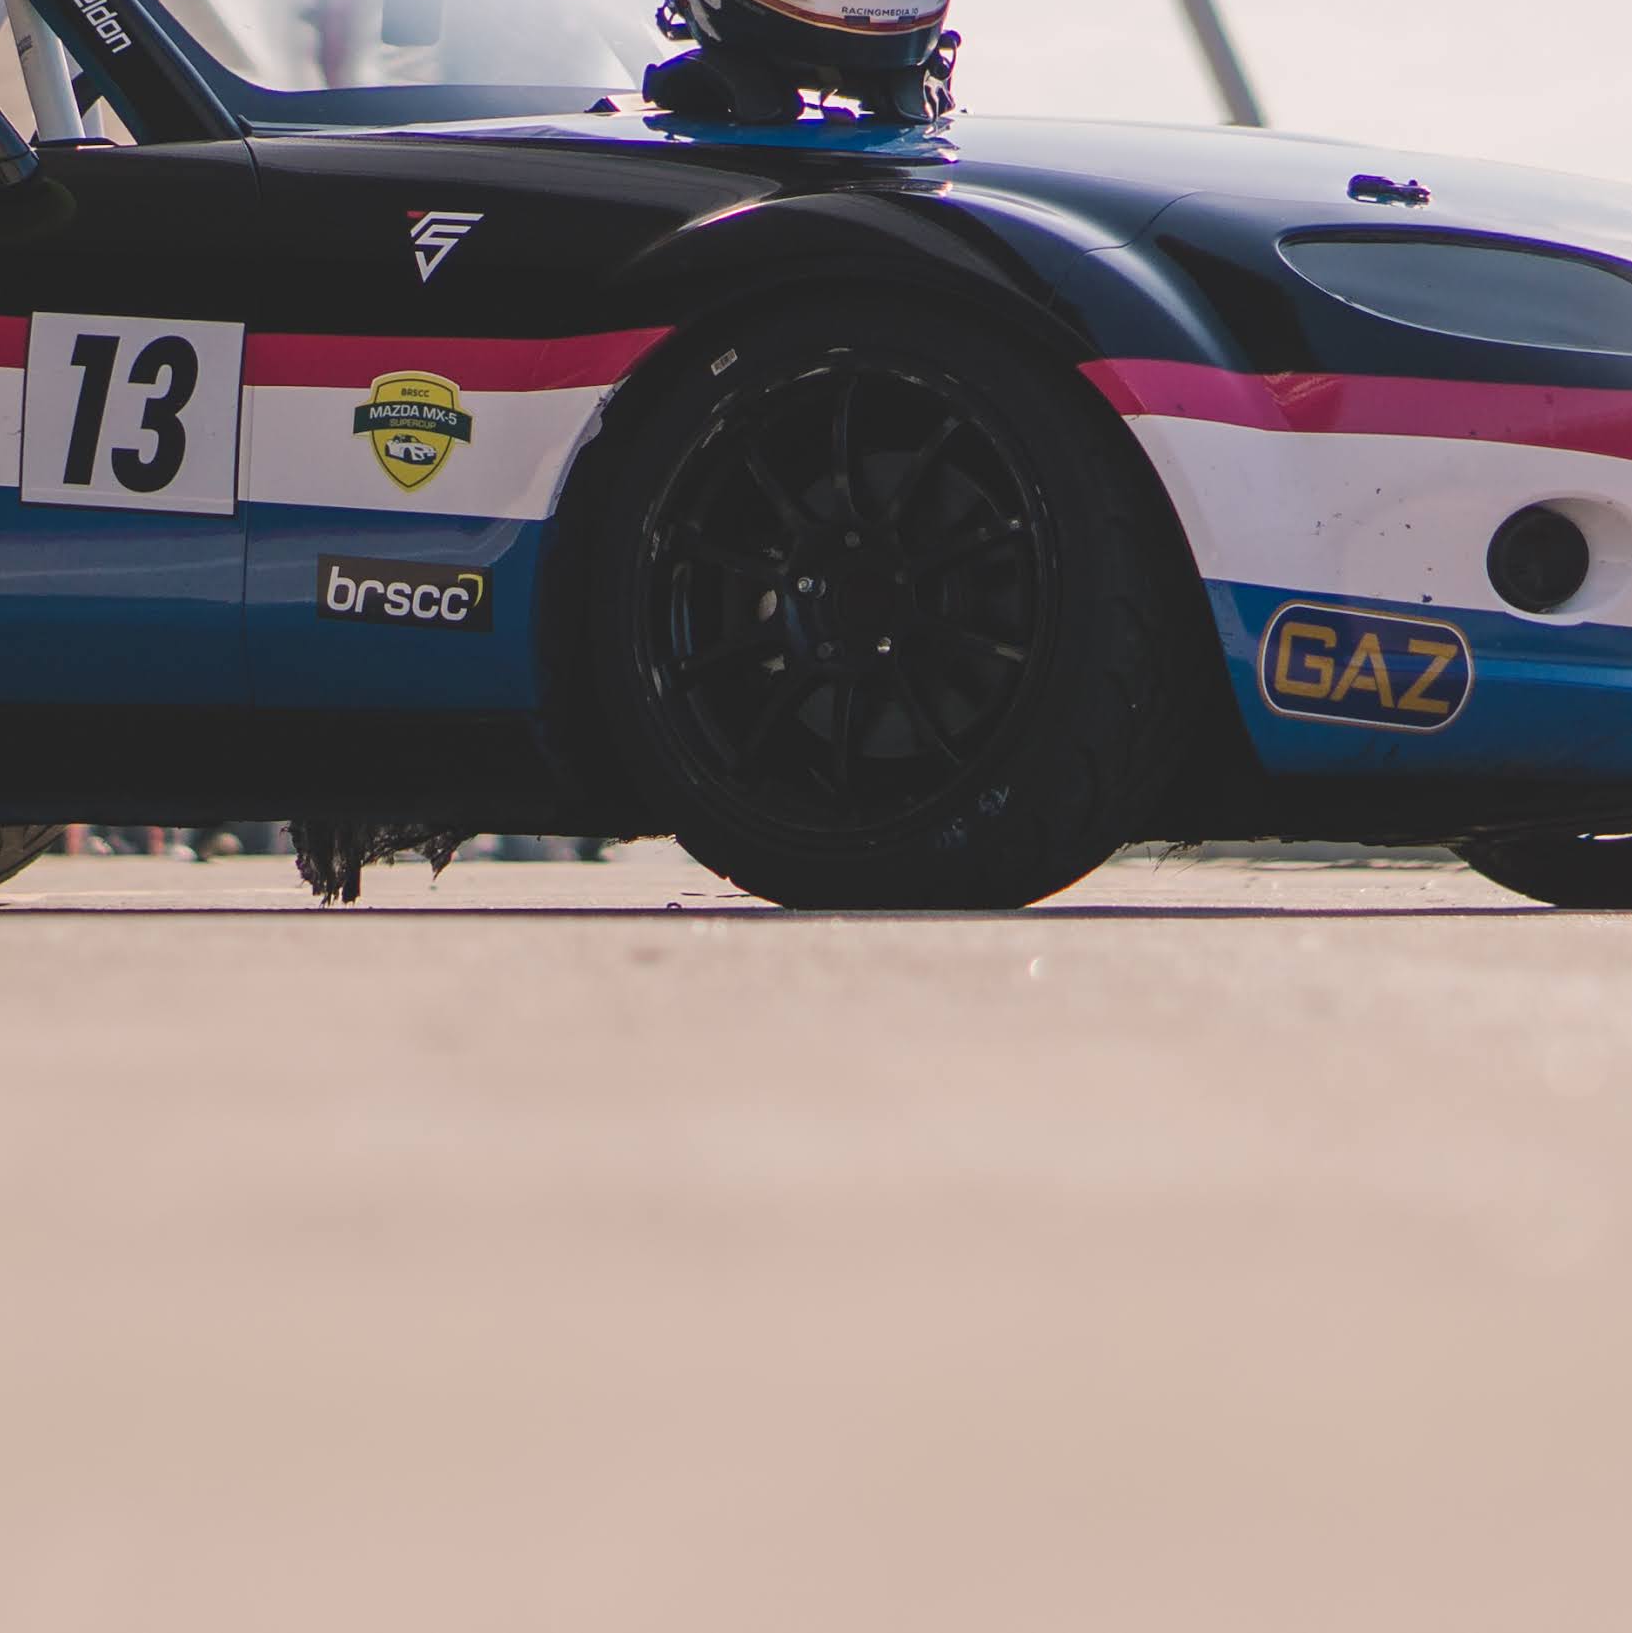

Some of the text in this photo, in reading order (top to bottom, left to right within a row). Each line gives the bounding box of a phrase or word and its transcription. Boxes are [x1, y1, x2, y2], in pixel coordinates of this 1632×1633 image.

[62, 331, 199, 493] 13
[401, 387, 430, 398] BRSCC
[369, 405, 458, 426] MAZDA MX-5
[390, 419, 437, 429] SUPERCUP
[326, 565, 470, 622] brscc
[1273, 622, 1461, 715] GAZ
